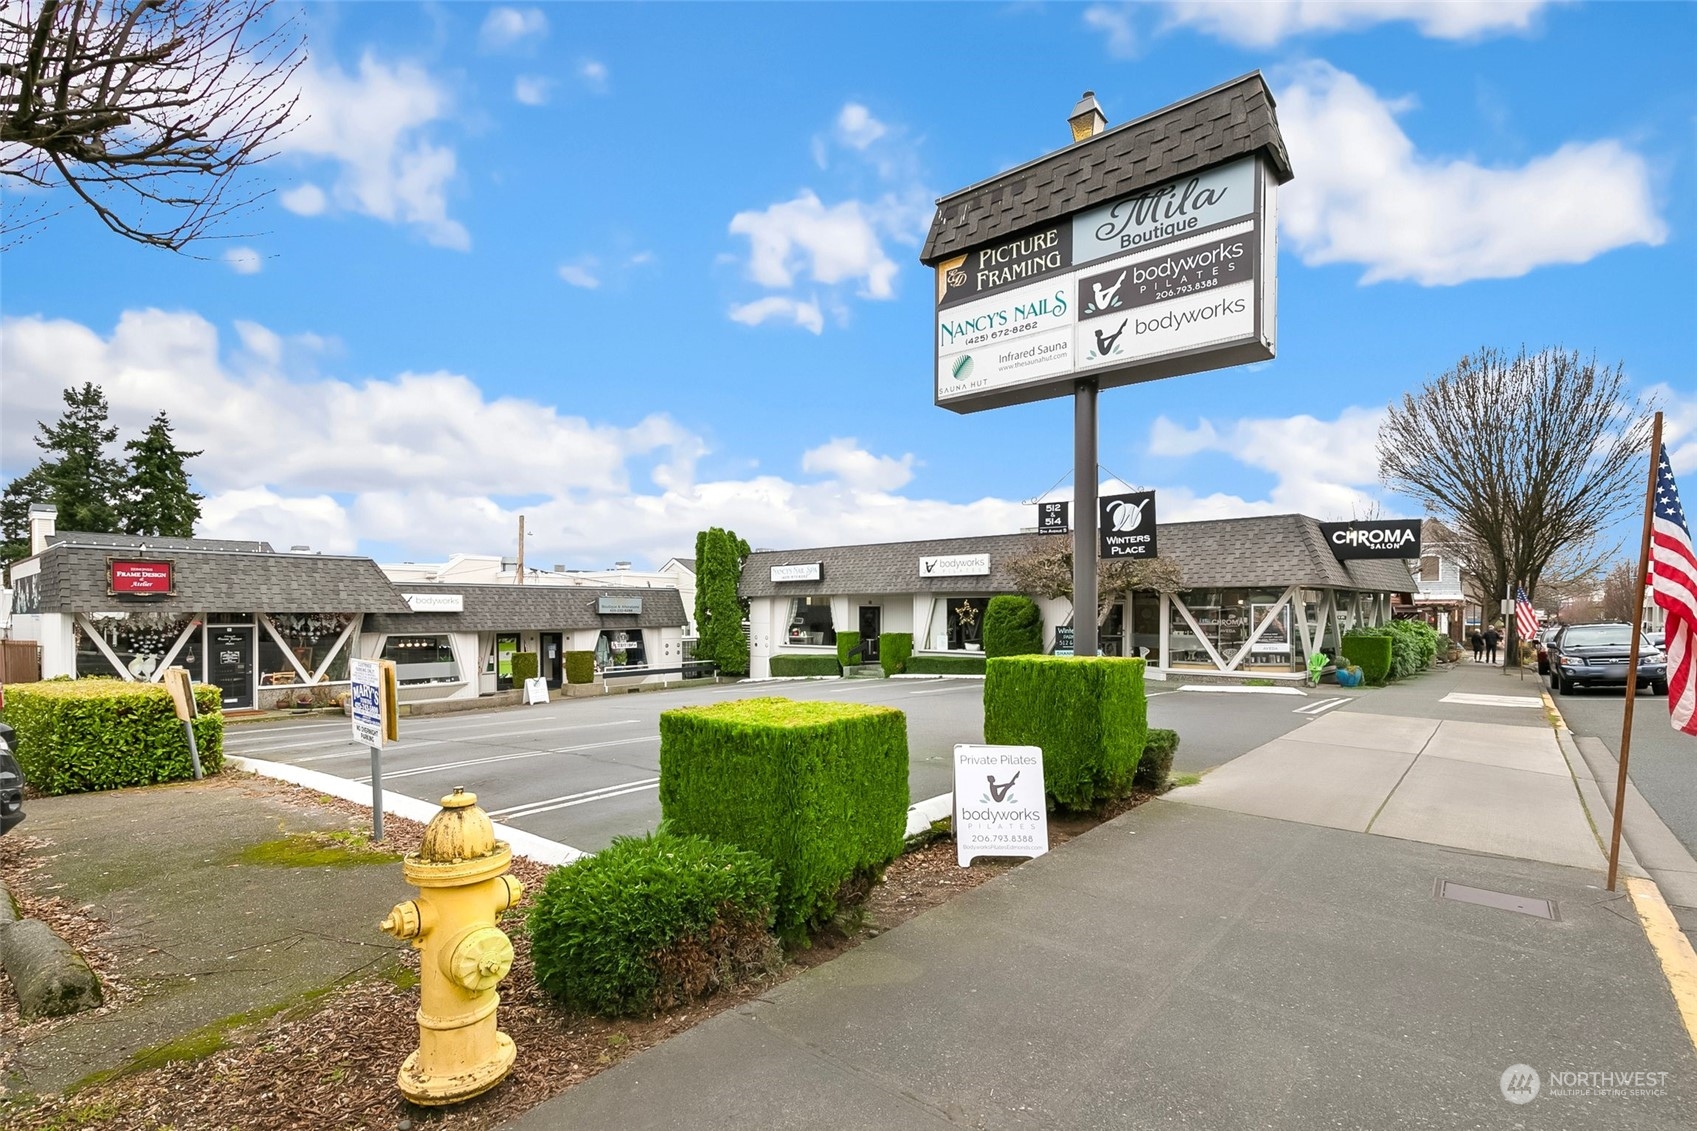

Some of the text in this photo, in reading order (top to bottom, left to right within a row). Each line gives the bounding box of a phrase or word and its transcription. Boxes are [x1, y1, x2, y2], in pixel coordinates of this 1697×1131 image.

[1095, 177, 1228, 241] Mila
[1120, 216, 1198, 249] Boutique
[978, 229, 1059, 270] PICTURE
[976, 251, 1061, 291] FRAMING
[1133, 243, 1244, 284] bodyworks
[1140, 262, 1235, 293] PILATES
[1156, 278, 1218, 300] 206.793.8388
[941, 290, 1067, 347] NANCY'S NAILS
[1135, 298, 1246, 335] bodyworks
[965, 321, 1038, 346] (425) 672-8262
[998, 341, 1068, 363] Infrared Sauna
[998, 352, 1068, 372] www.thesaunahut.com
[939, 378, 988, 394] SAUNA HUT
[1045, 504, 1061, 512] 512
[1044, 517, 1062, 526] 514
[1106, 535, 1151, 545] WINTERS
[1332, 528, 1416, 547] CHROMA
[1111, 546, 1146, 555] PLACE
[940, 557, 985, 569] bodyworks
[415, 596, 459, 605] bodyworks
[353, 684, 379, 706] MARY'S
[960, 754, 1037, 765] Private Pilates
[962, 808, 1041, 824] bodyworks
[972, 834, 1034, 843] 206.793.8388
